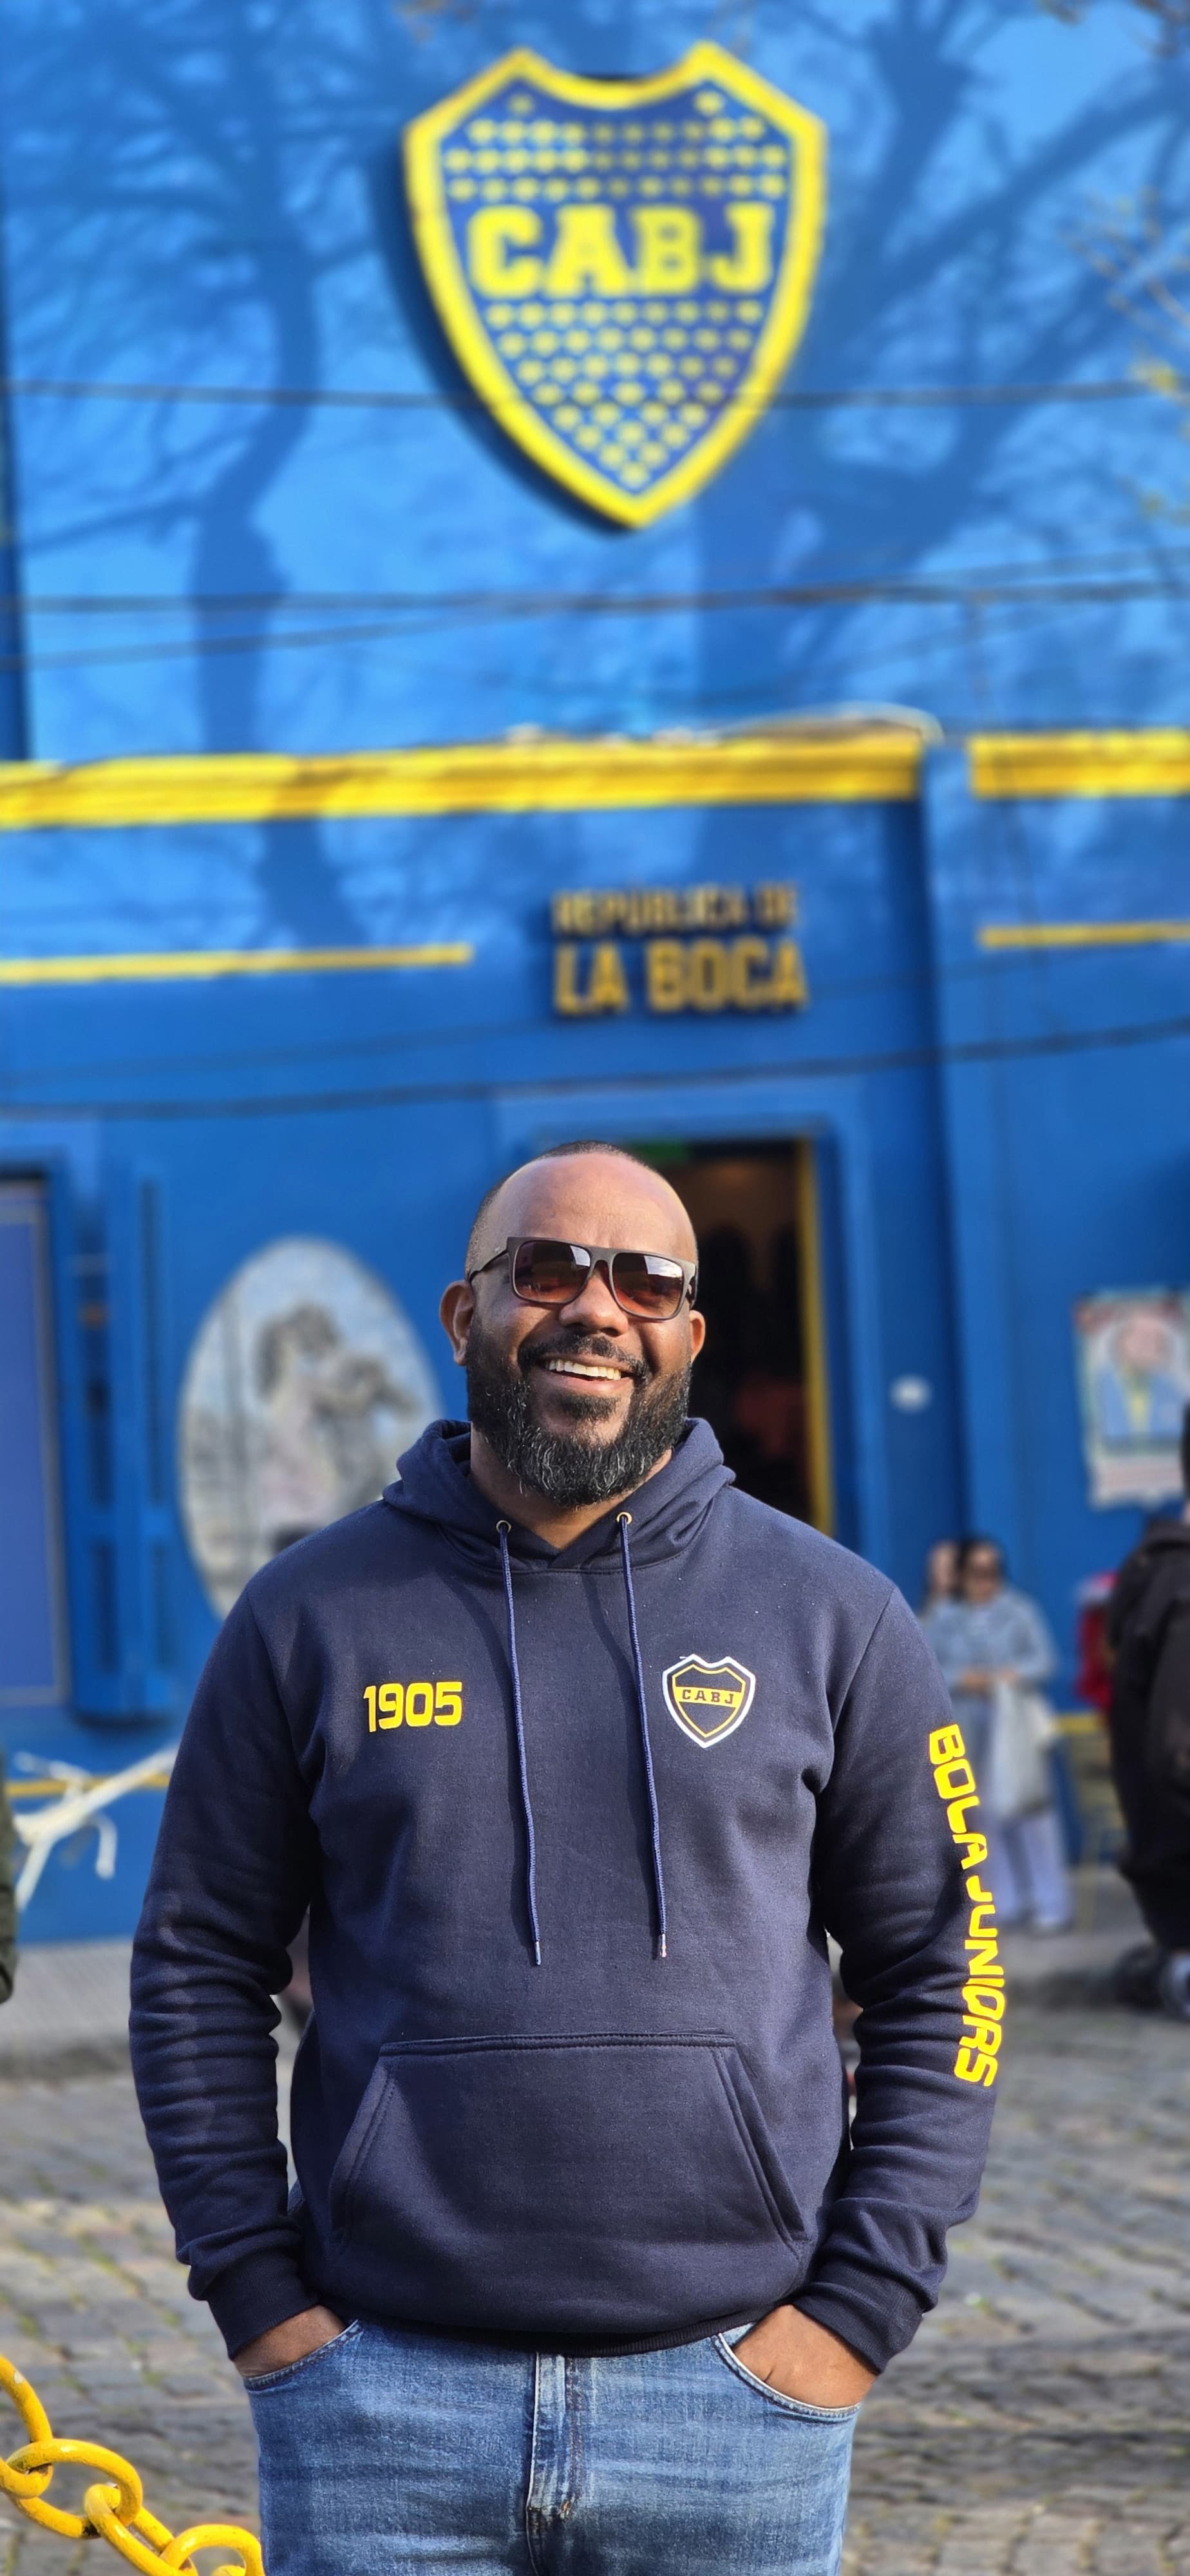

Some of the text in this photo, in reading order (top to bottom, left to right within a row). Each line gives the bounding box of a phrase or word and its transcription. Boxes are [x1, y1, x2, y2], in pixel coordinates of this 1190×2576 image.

[466, 201, 774, 298] CABJ
[554, 935, 808, 1015] LA BOCA
[363, 1681, 462, 1732] 1905
[682, 1689, 734, 1704] CABJ
[929, 1723, 1006, 2087] BOLA JUNIORS
